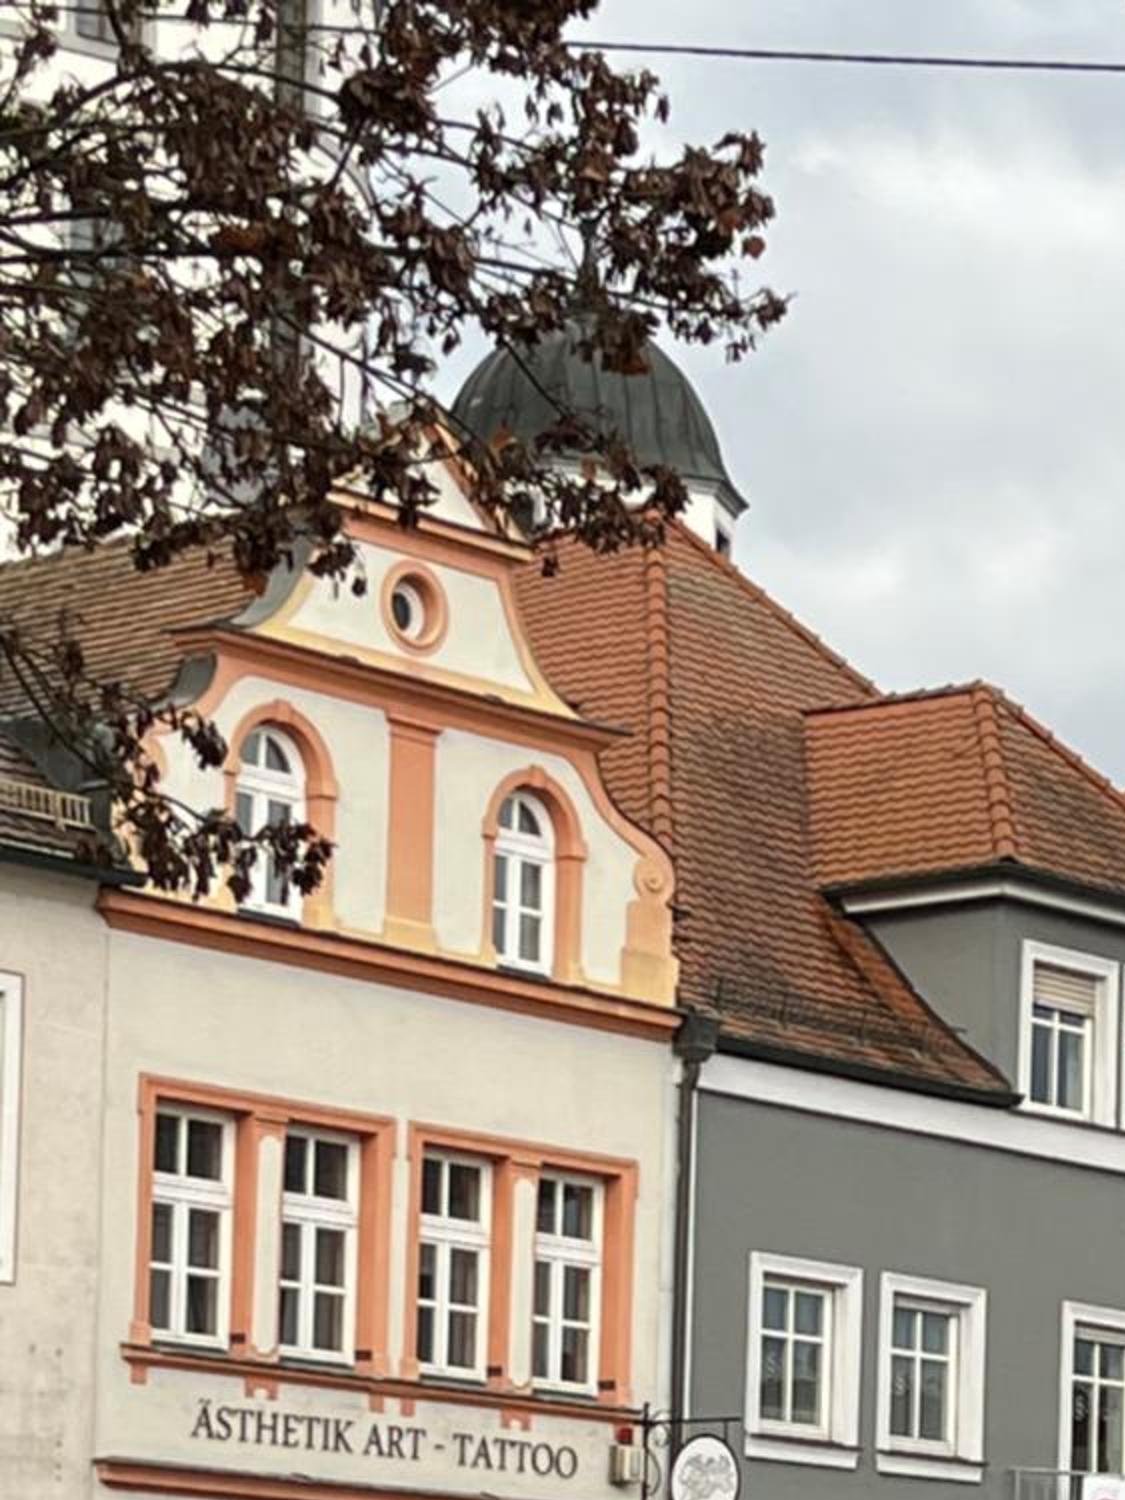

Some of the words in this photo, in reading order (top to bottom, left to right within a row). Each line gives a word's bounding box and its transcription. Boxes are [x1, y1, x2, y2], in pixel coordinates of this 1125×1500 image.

[191, 1399, 355, 1454] ÄSTHETIK
[362, 1423, 427, 1462] ART
[452, 1432, 579, 1479] TATTOO
